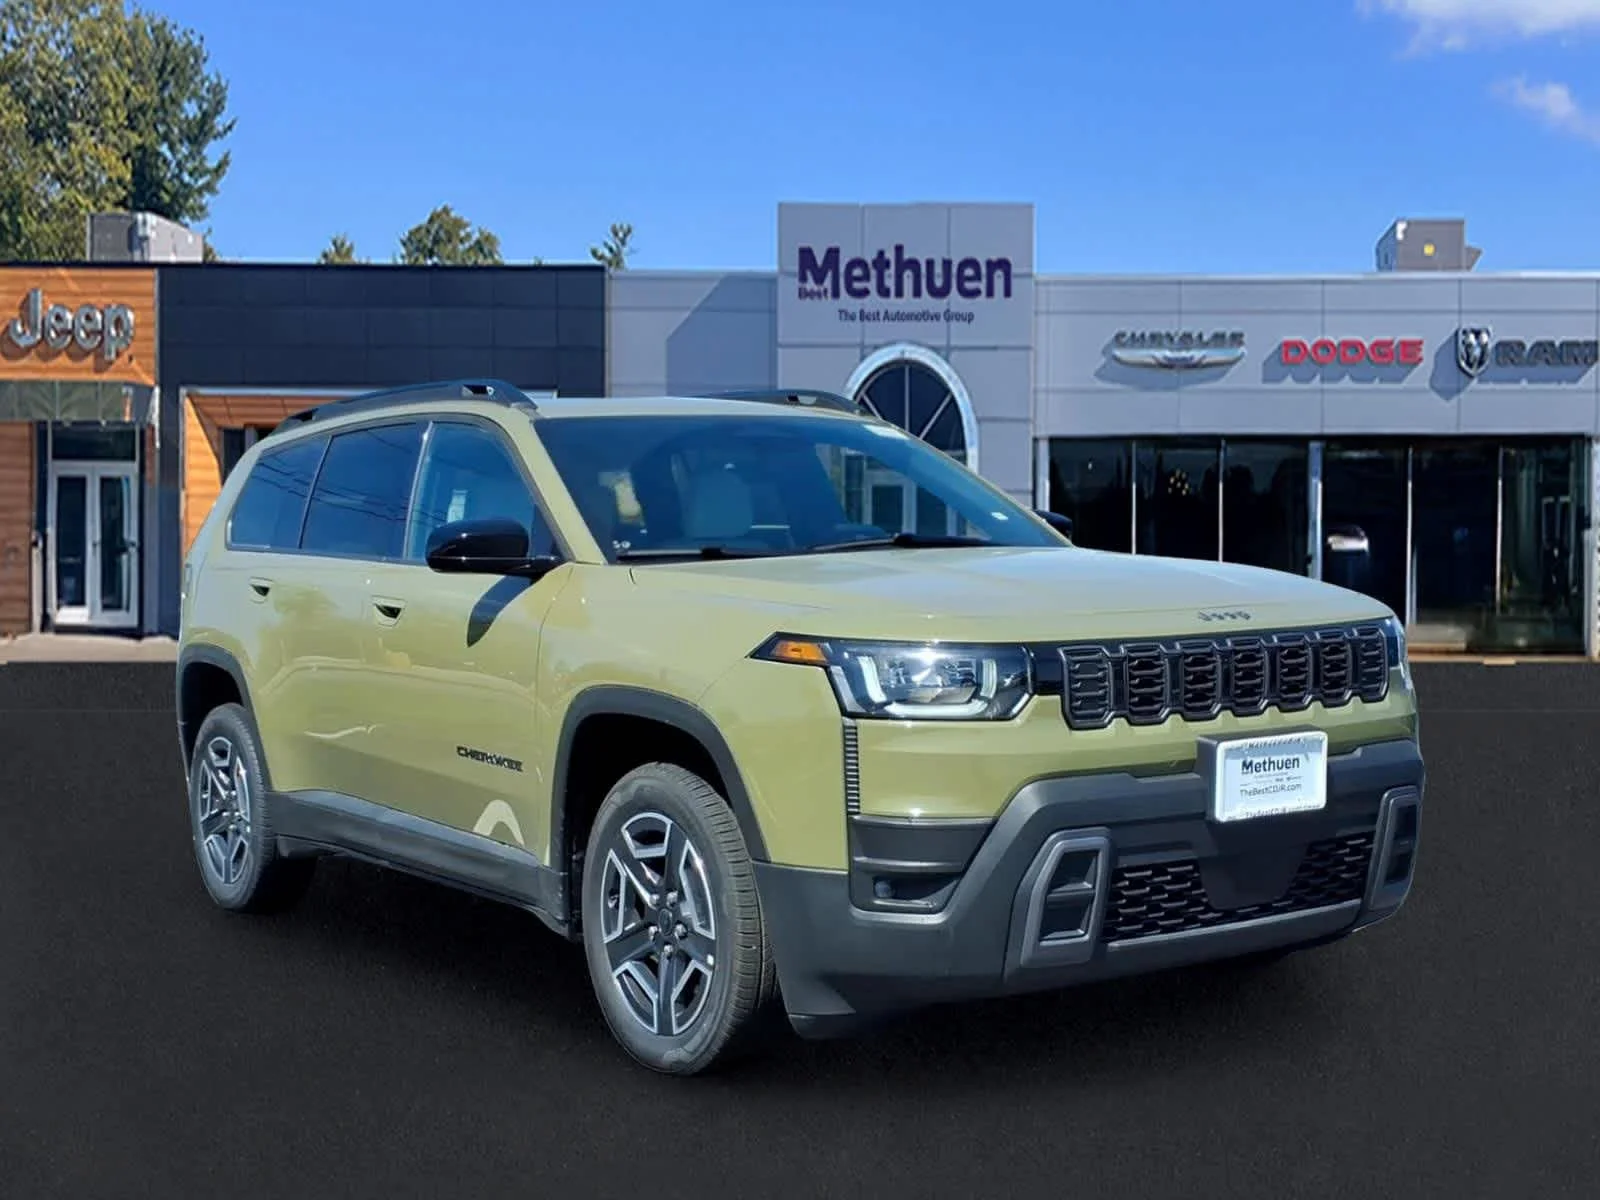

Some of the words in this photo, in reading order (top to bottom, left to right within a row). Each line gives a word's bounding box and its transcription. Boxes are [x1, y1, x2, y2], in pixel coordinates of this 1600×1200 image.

[798, 244, 1012, 299] Methuen
[9, 288, 135, 361] Jeep
[838, 309, 857, 322] The
[859, 309, 880, 322] Best
[882, 309, 941, 322] Automotive
[943, 309, 975, 325] Group
[1114, 331, 1245, 347] CHRYSLER
[1281, 339, 1424, 365] DODGE
[1495, 340, 1599, 366] RAM
[1241, 756, 1300, 774] Methuen
